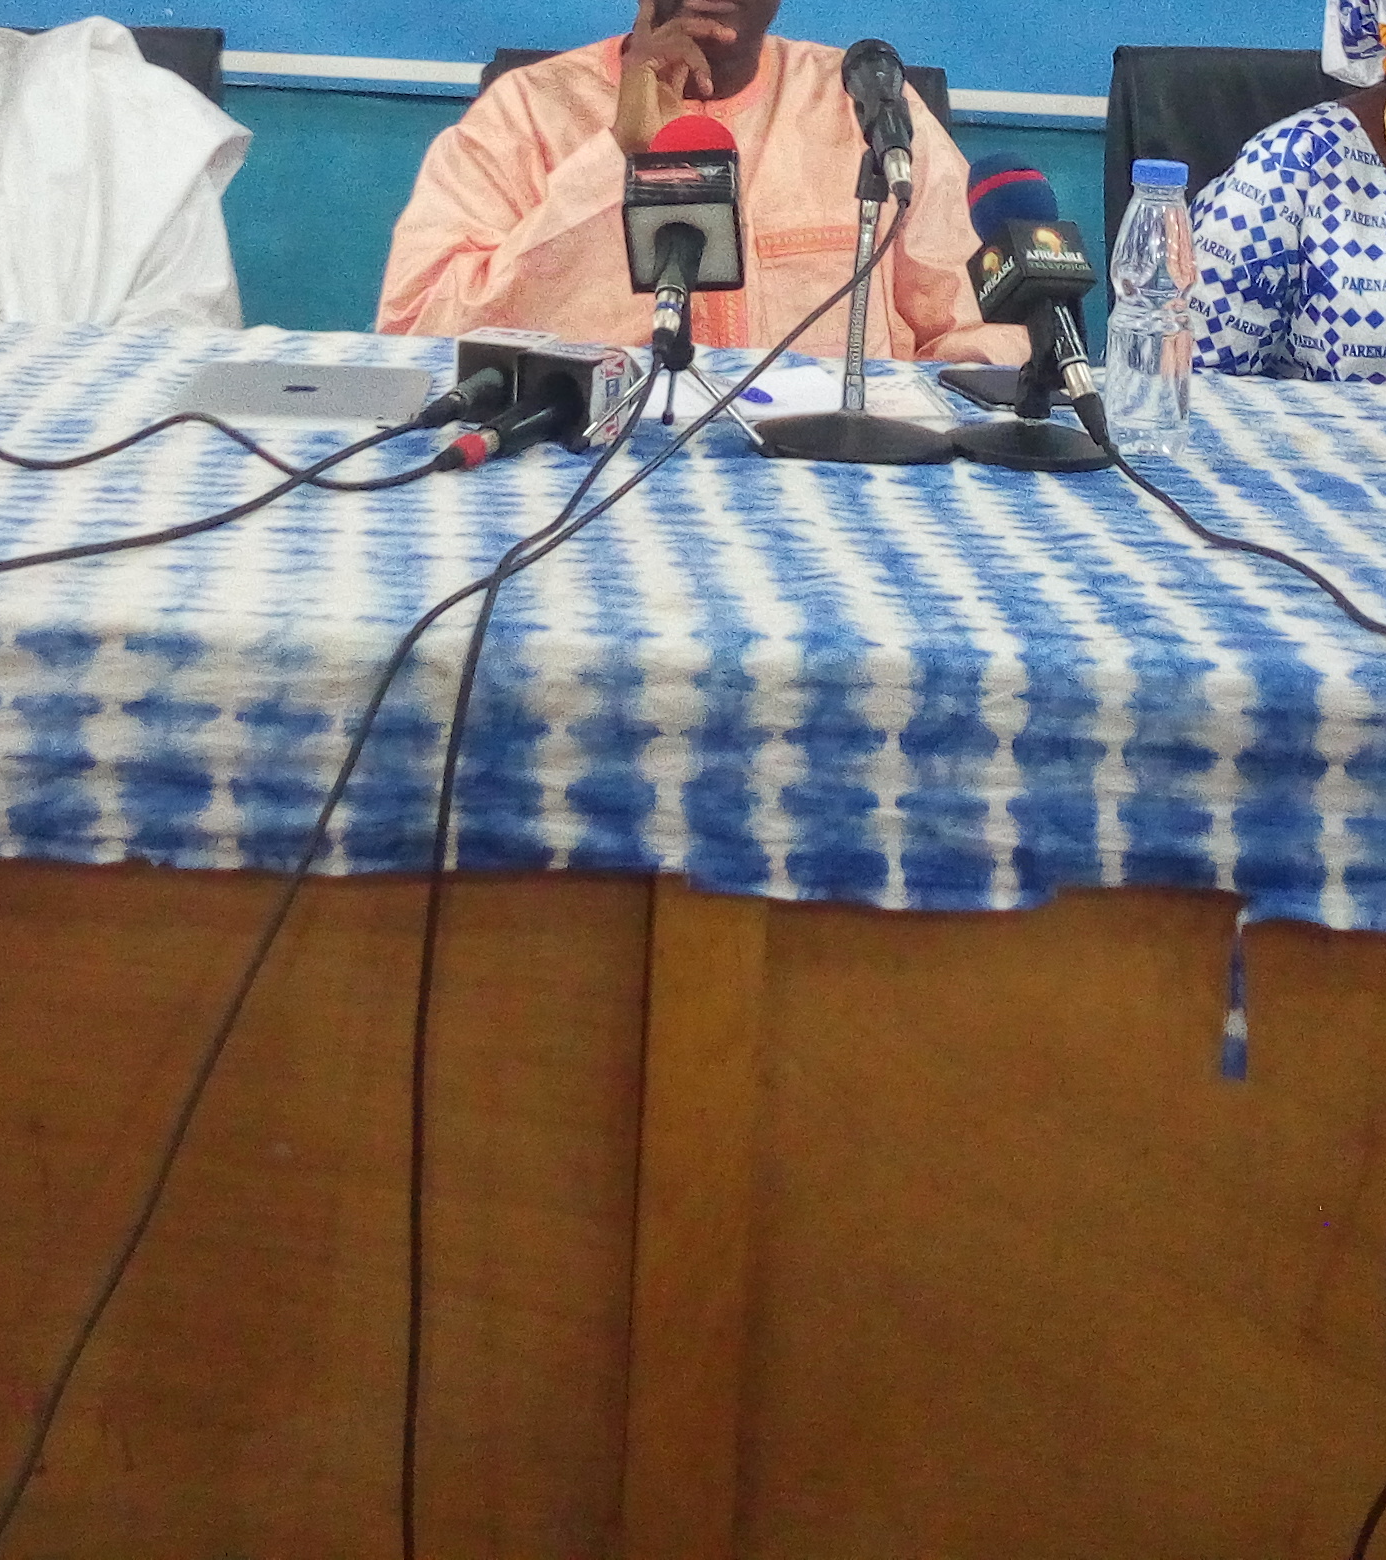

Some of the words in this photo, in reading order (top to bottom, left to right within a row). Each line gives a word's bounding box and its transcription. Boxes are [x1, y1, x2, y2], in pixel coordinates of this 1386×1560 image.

[1228, 177, 1267, 205] PARENA
[1344, 209, 1386, 229] PARENA
[1194, 235, 1238, 265] PARENA
